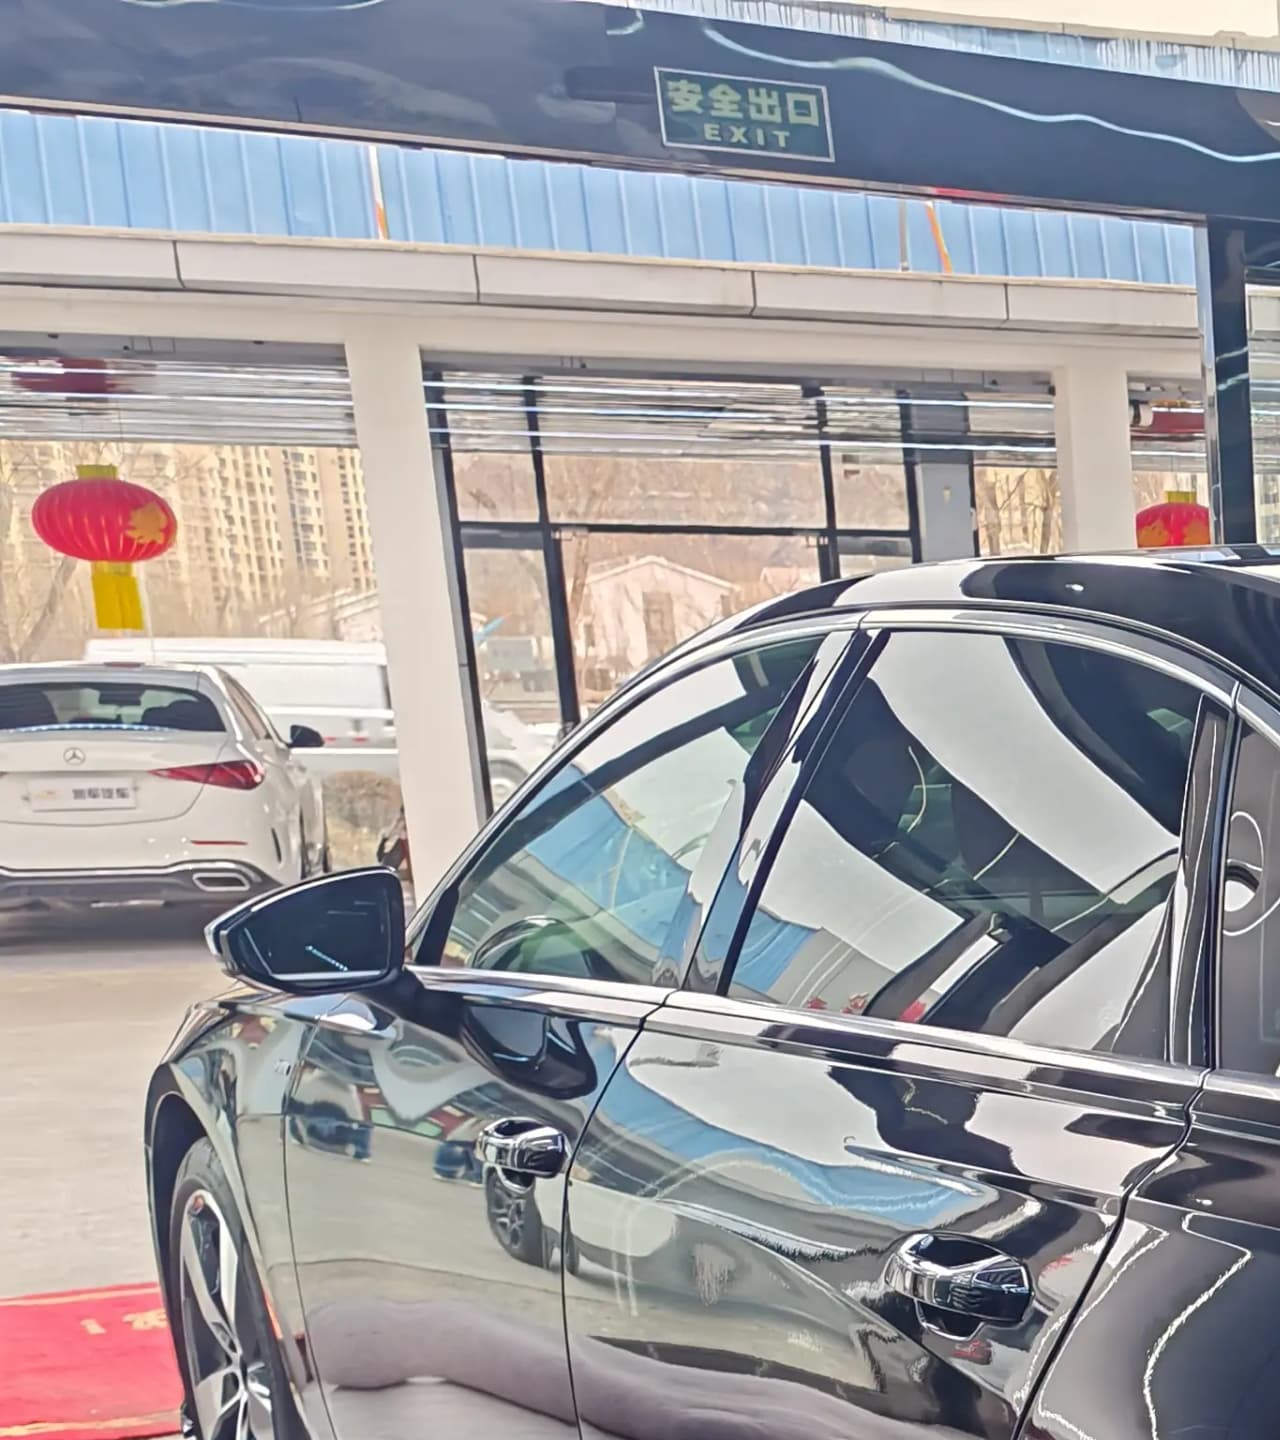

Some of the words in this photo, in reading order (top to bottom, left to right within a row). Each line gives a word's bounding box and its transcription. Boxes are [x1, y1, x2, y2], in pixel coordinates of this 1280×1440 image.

[667, 79, 819, 126] 安全出口
[703, 123, 790, 147] EXIT
